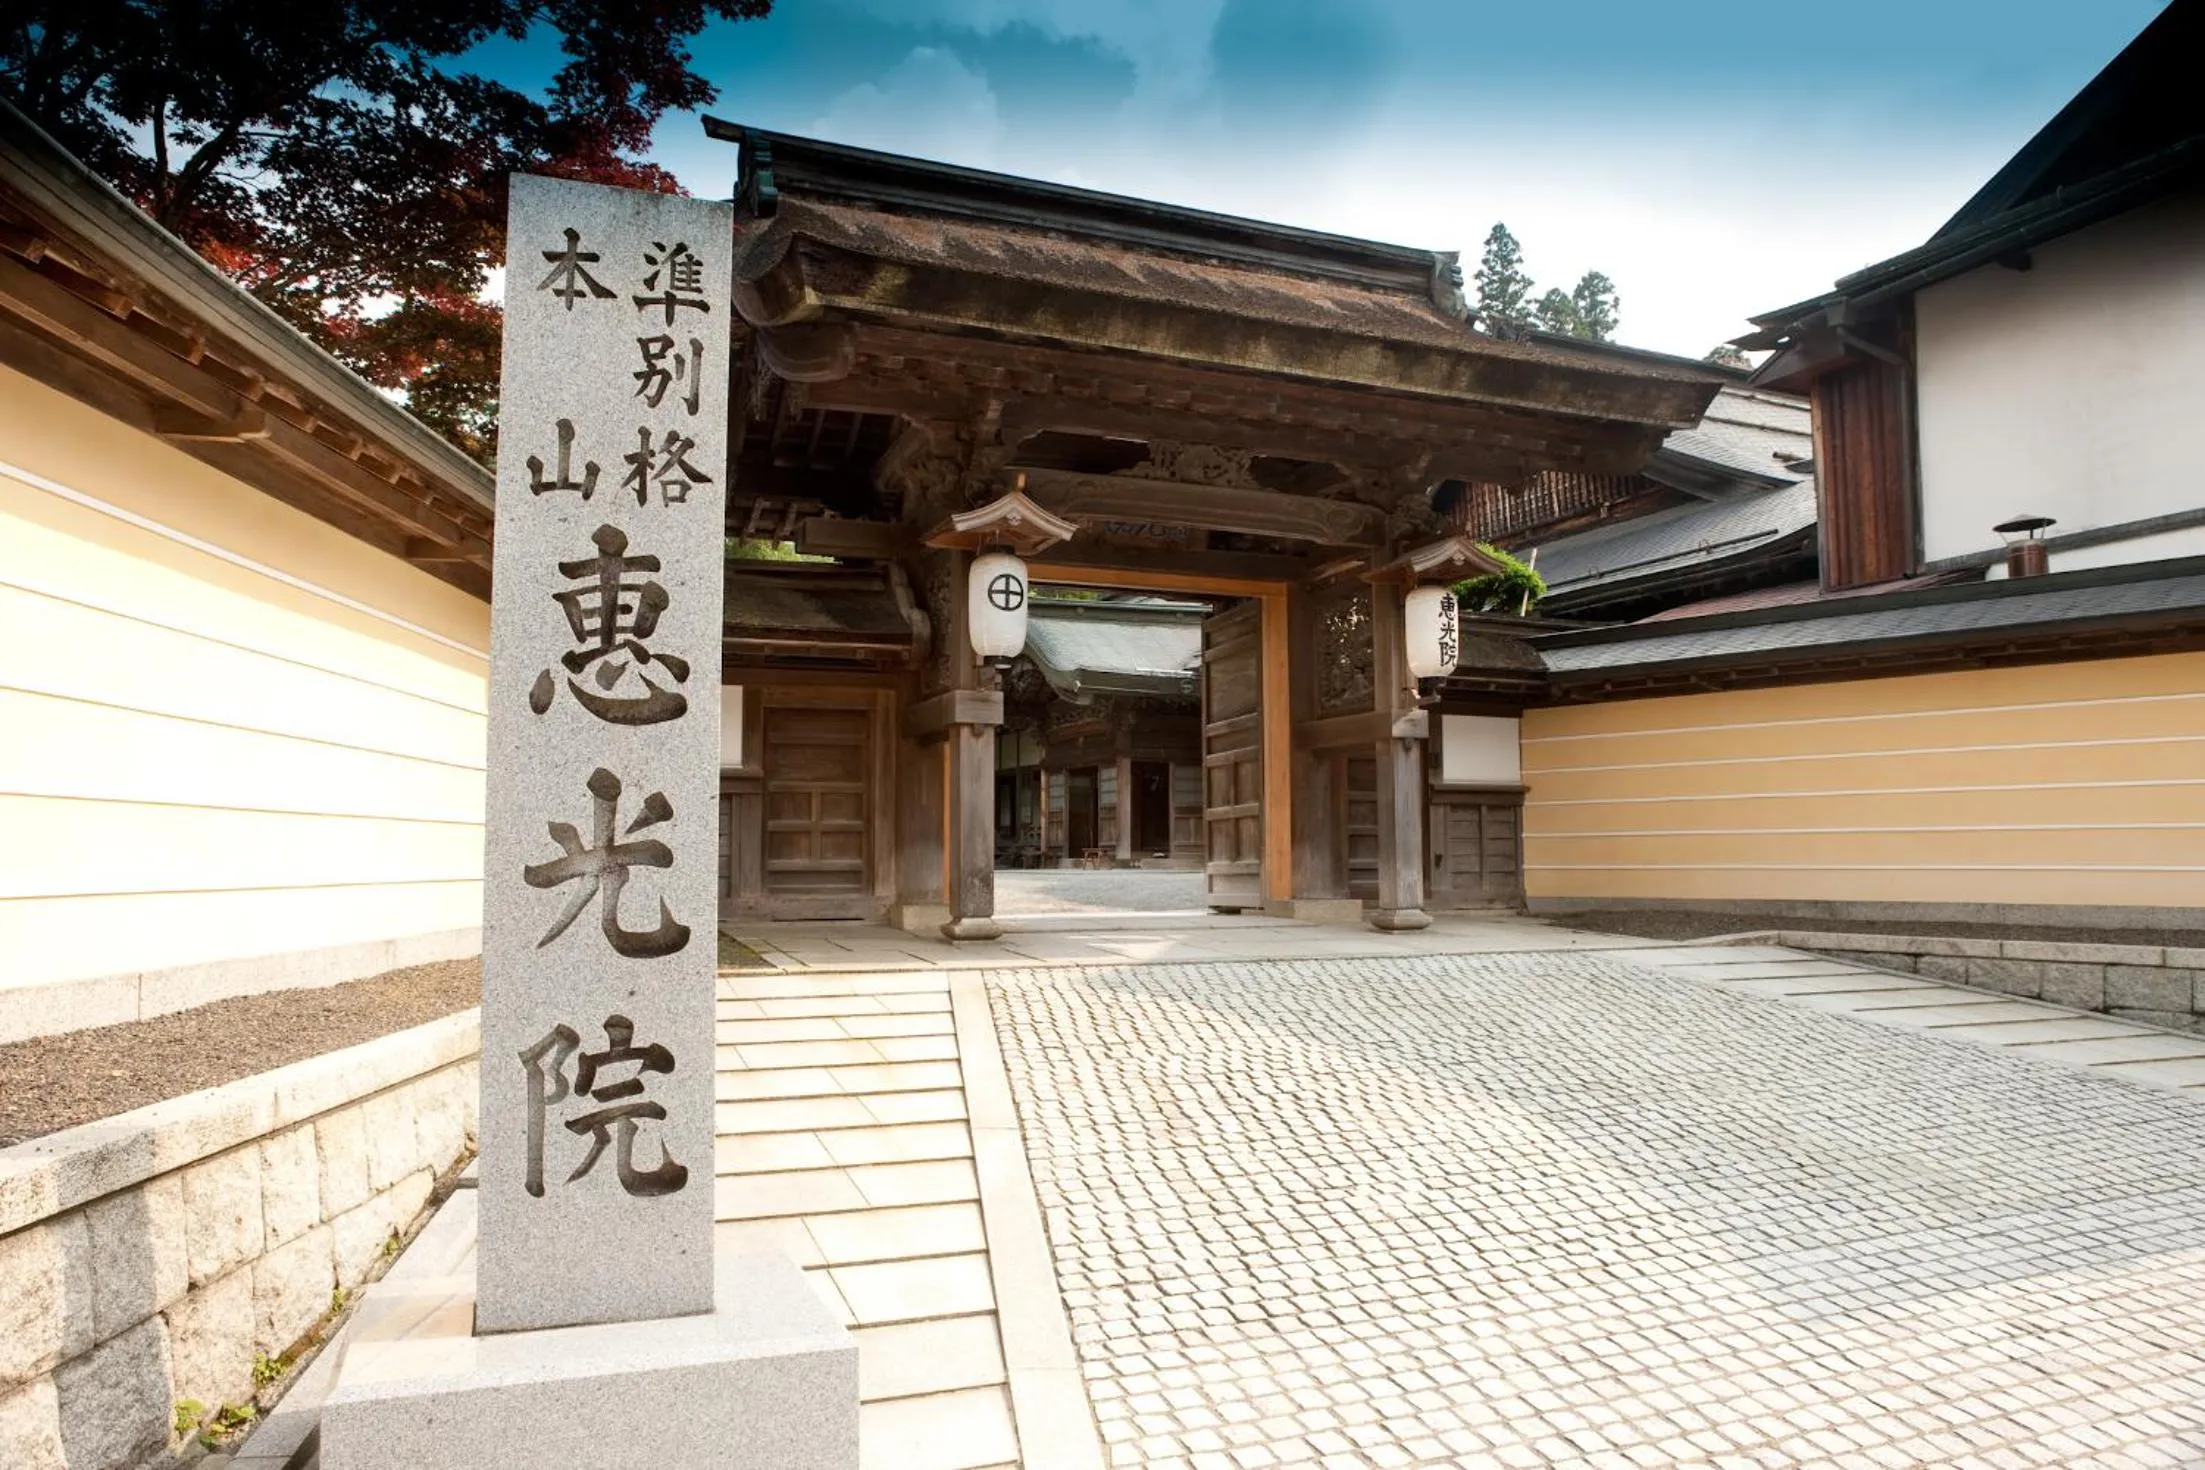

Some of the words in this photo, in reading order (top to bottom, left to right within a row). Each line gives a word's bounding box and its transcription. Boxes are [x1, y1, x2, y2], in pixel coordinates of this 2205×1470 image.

[526, 227, 617, 501] 本山
[621, 241, 713, 508] 準別格
